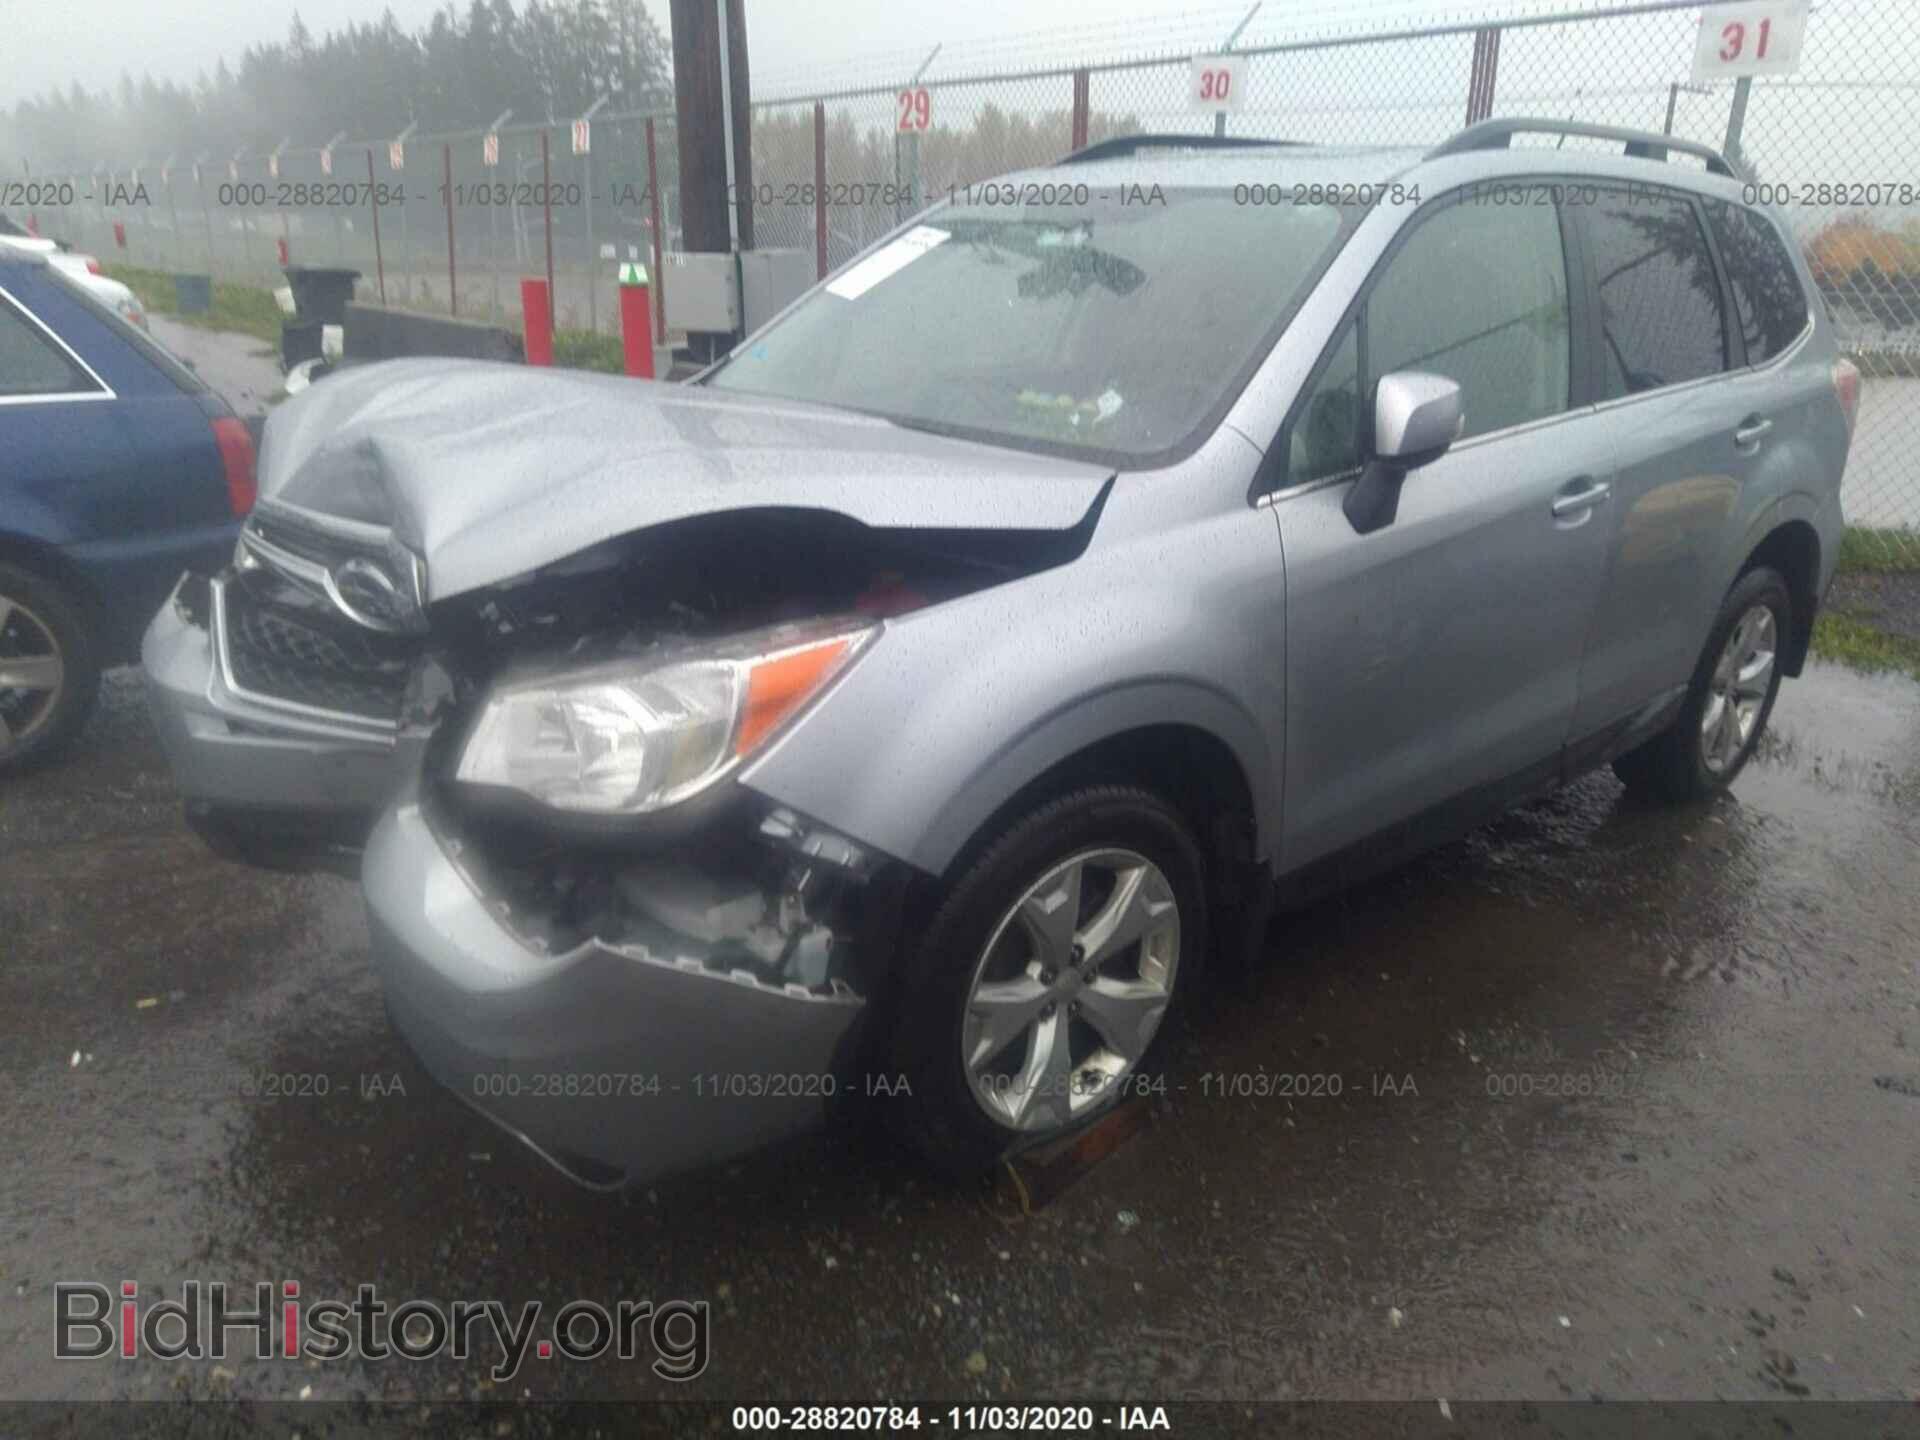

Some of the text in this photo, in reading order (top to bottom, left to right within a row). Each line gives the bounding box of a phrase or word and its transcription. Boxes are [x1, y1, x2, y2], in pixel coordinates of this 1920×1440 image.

[1720, 18, 1771, 61] 31
[1200, 69, 1230, 100] 30
[898, 86, 929, 129] 29
